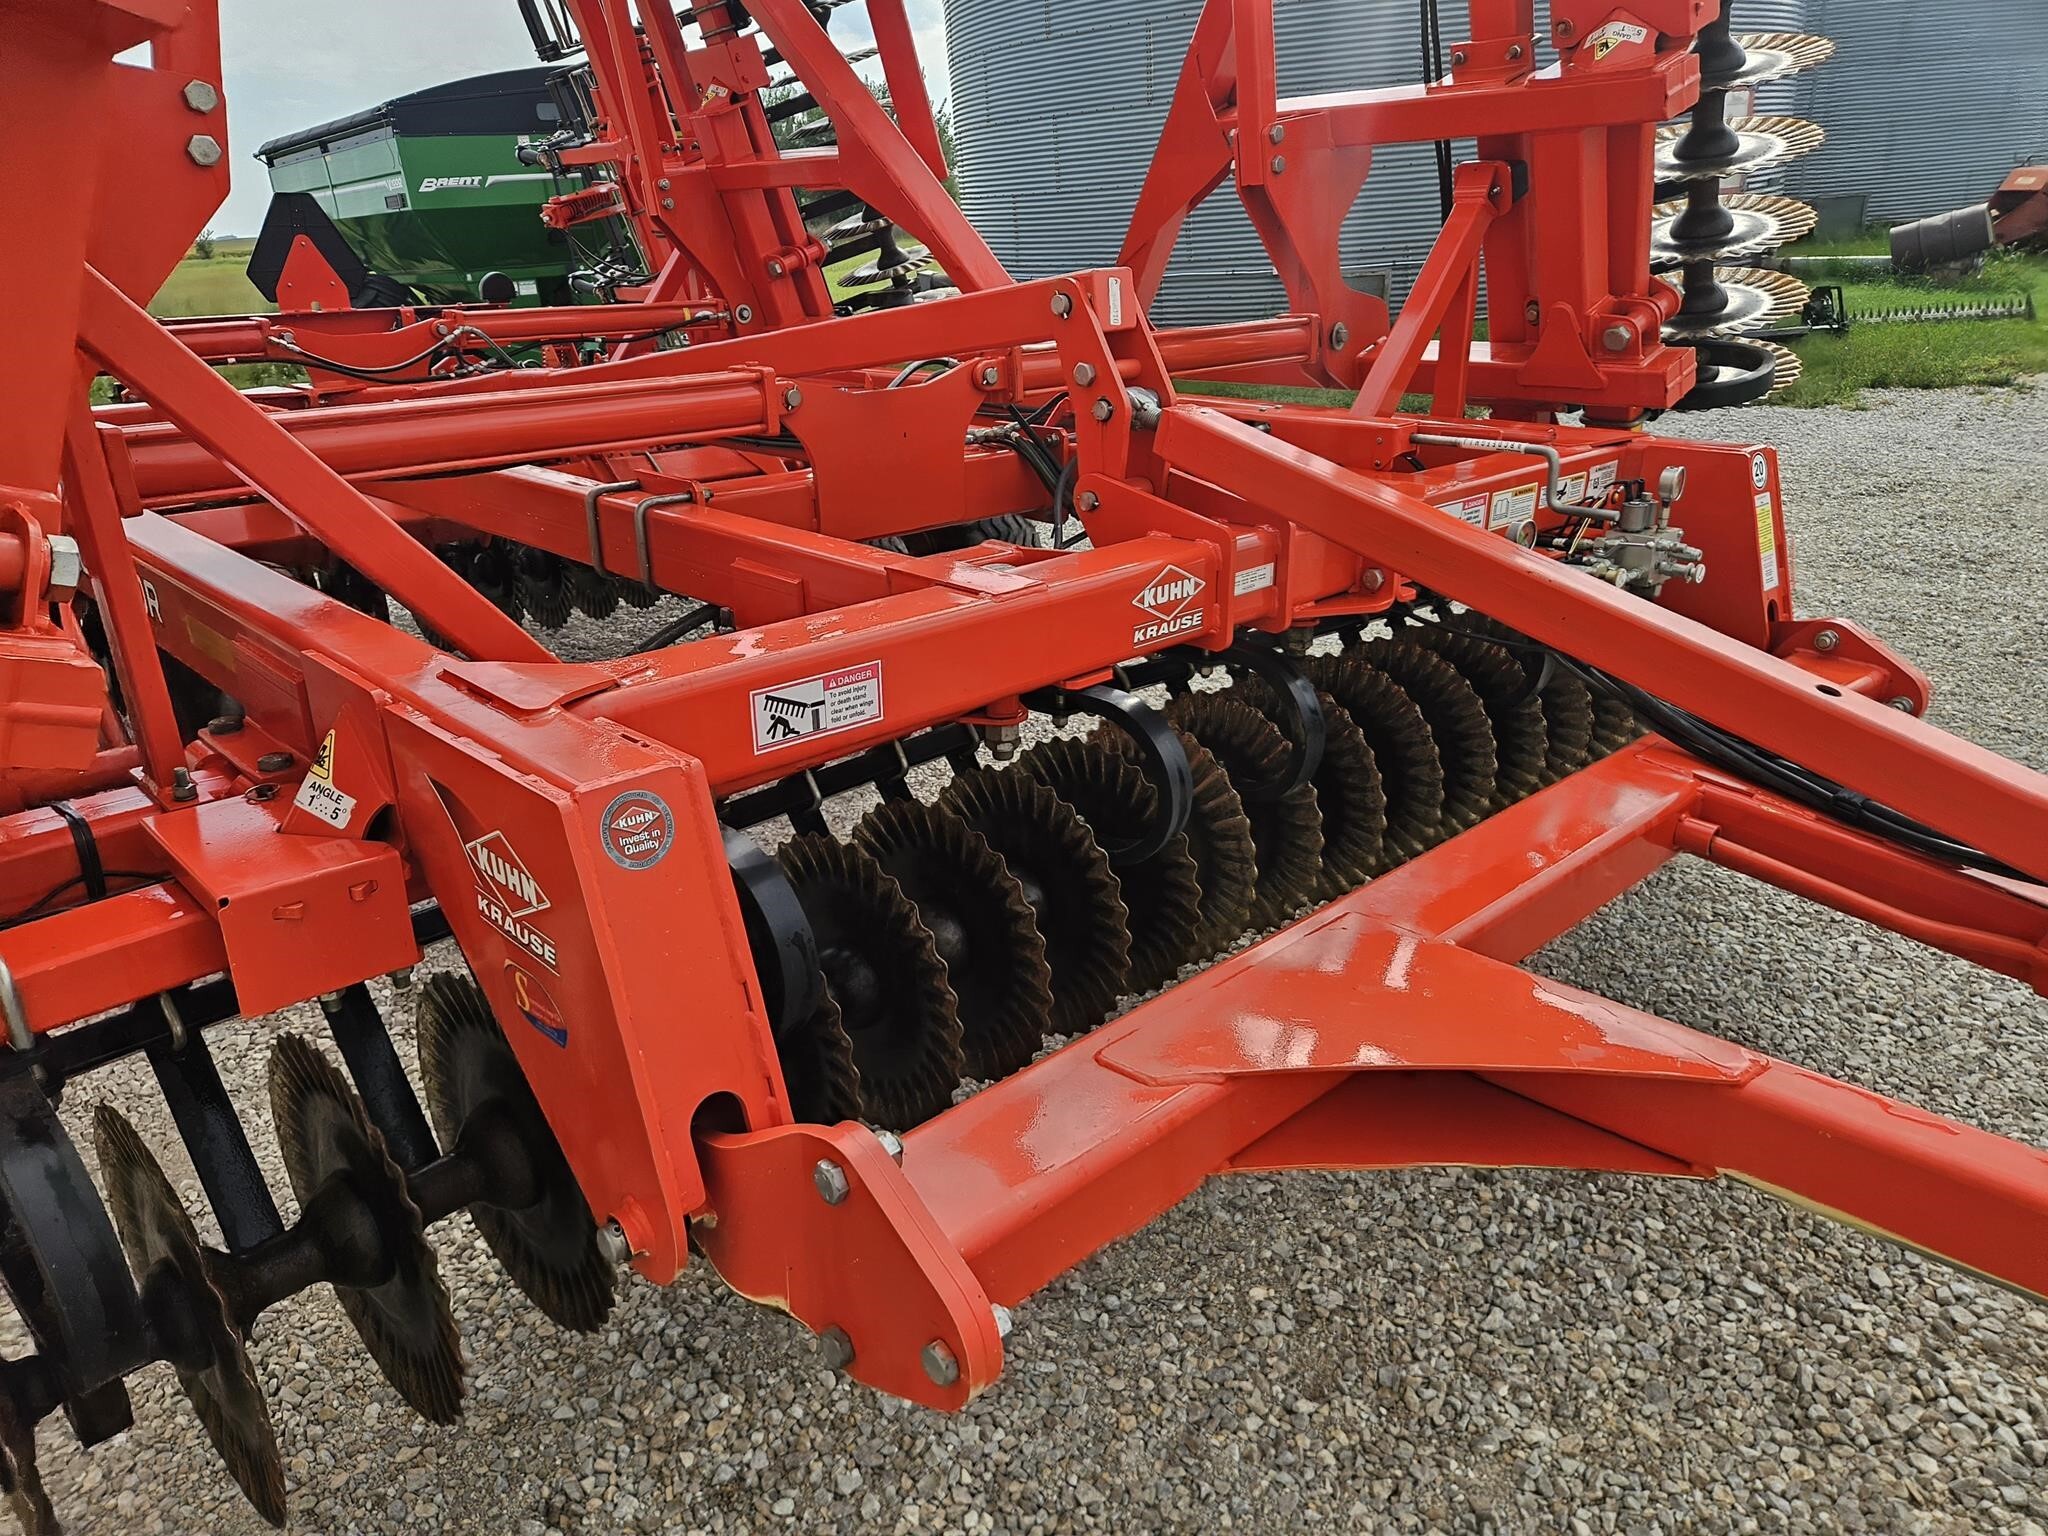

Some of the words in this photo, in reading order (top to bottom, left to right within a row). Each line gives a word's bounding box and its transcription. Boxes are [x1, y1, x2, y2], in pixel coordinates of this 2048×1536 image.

[418, 176, 482, 192] BRENT
[1754, 461, 1764, 477] 20
[1143, 577, 1196, 609] KUHN
[1133, 611, 1203, 643] KRAUSE
[837, 669, 872, 686] DANGER
[837, 697, 851, 706] death
[852, 693, 867, 701] stand
[838, 688, 852, 697] avoid
[831, 707, 843, 715] clear
[845, 703, 858, 711] when
[831, 715, 841, 723] fold
[308, 781, 345, 805] ANGLE
[619, 811, 654, 828] KUHN
[619, 832, 650, 846] Invest
[651, 829, 661, 837] in
[624, 839, 660, 855] Quality
[475, 841, 538, 909] KUHN
[477, 894, 557, 966] KRAUSE
